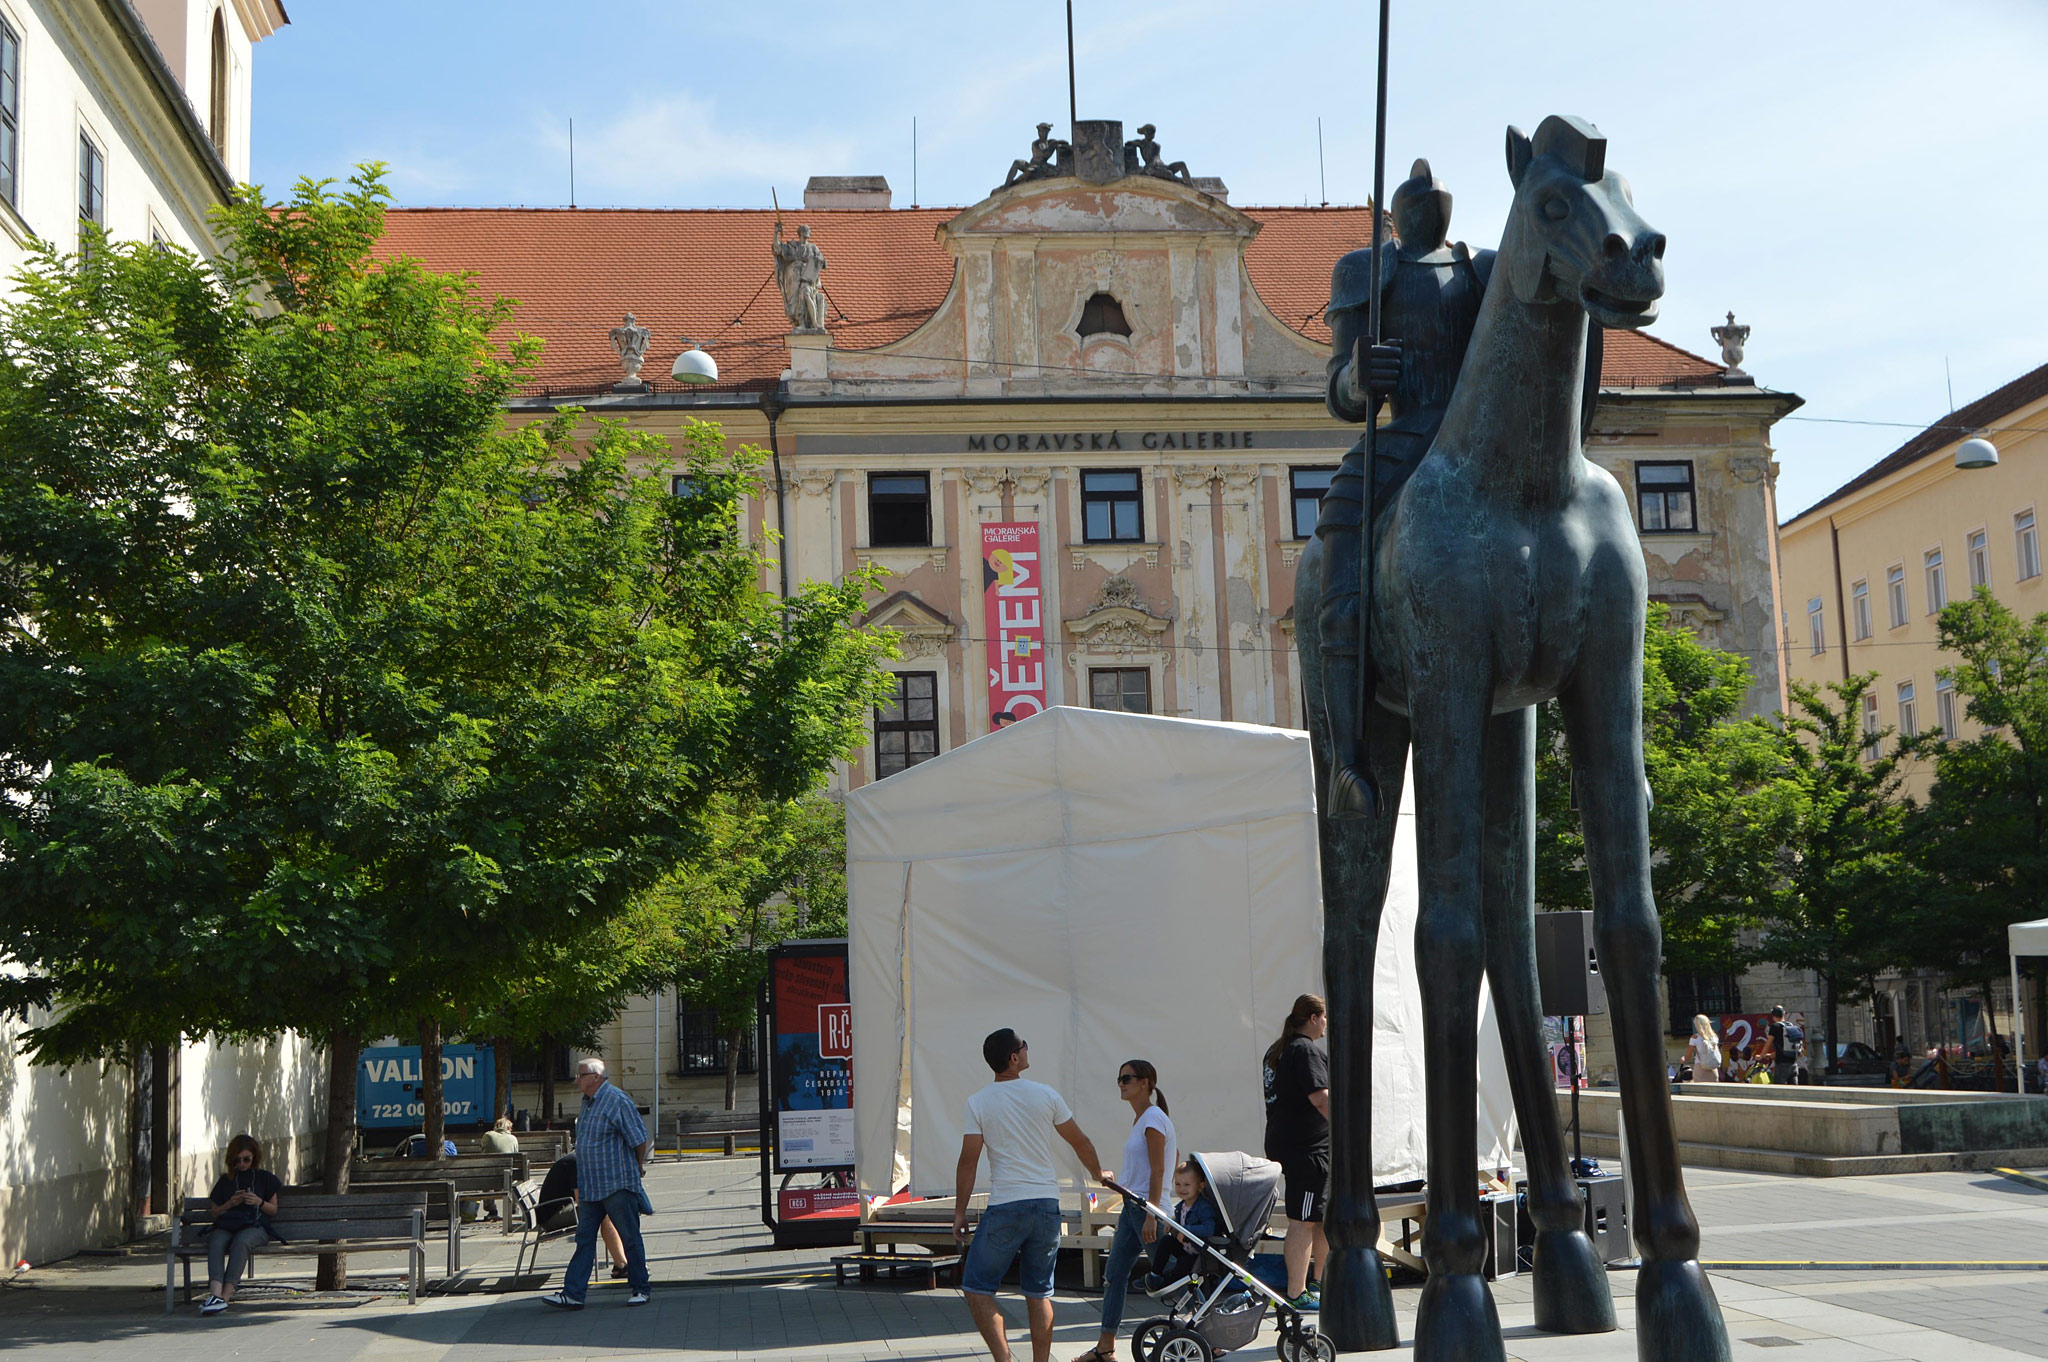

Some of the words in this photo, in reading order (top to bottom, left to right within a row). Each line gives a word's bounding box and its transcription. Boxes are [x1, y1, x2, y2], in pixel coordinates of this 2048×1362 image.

[968, 430, 1121, 451] MORAVSKÁ
[1142, 432, 1254, 450] GALERIE
[984, 525, 1036, 535] MORAVSKÁ
[984, 535, 1020, 543] GALERIE
[372, 1103, 402, 1118] 722
[406, 1102, 428, 1117] 00
[442, 1101, 471, 1116] 007
